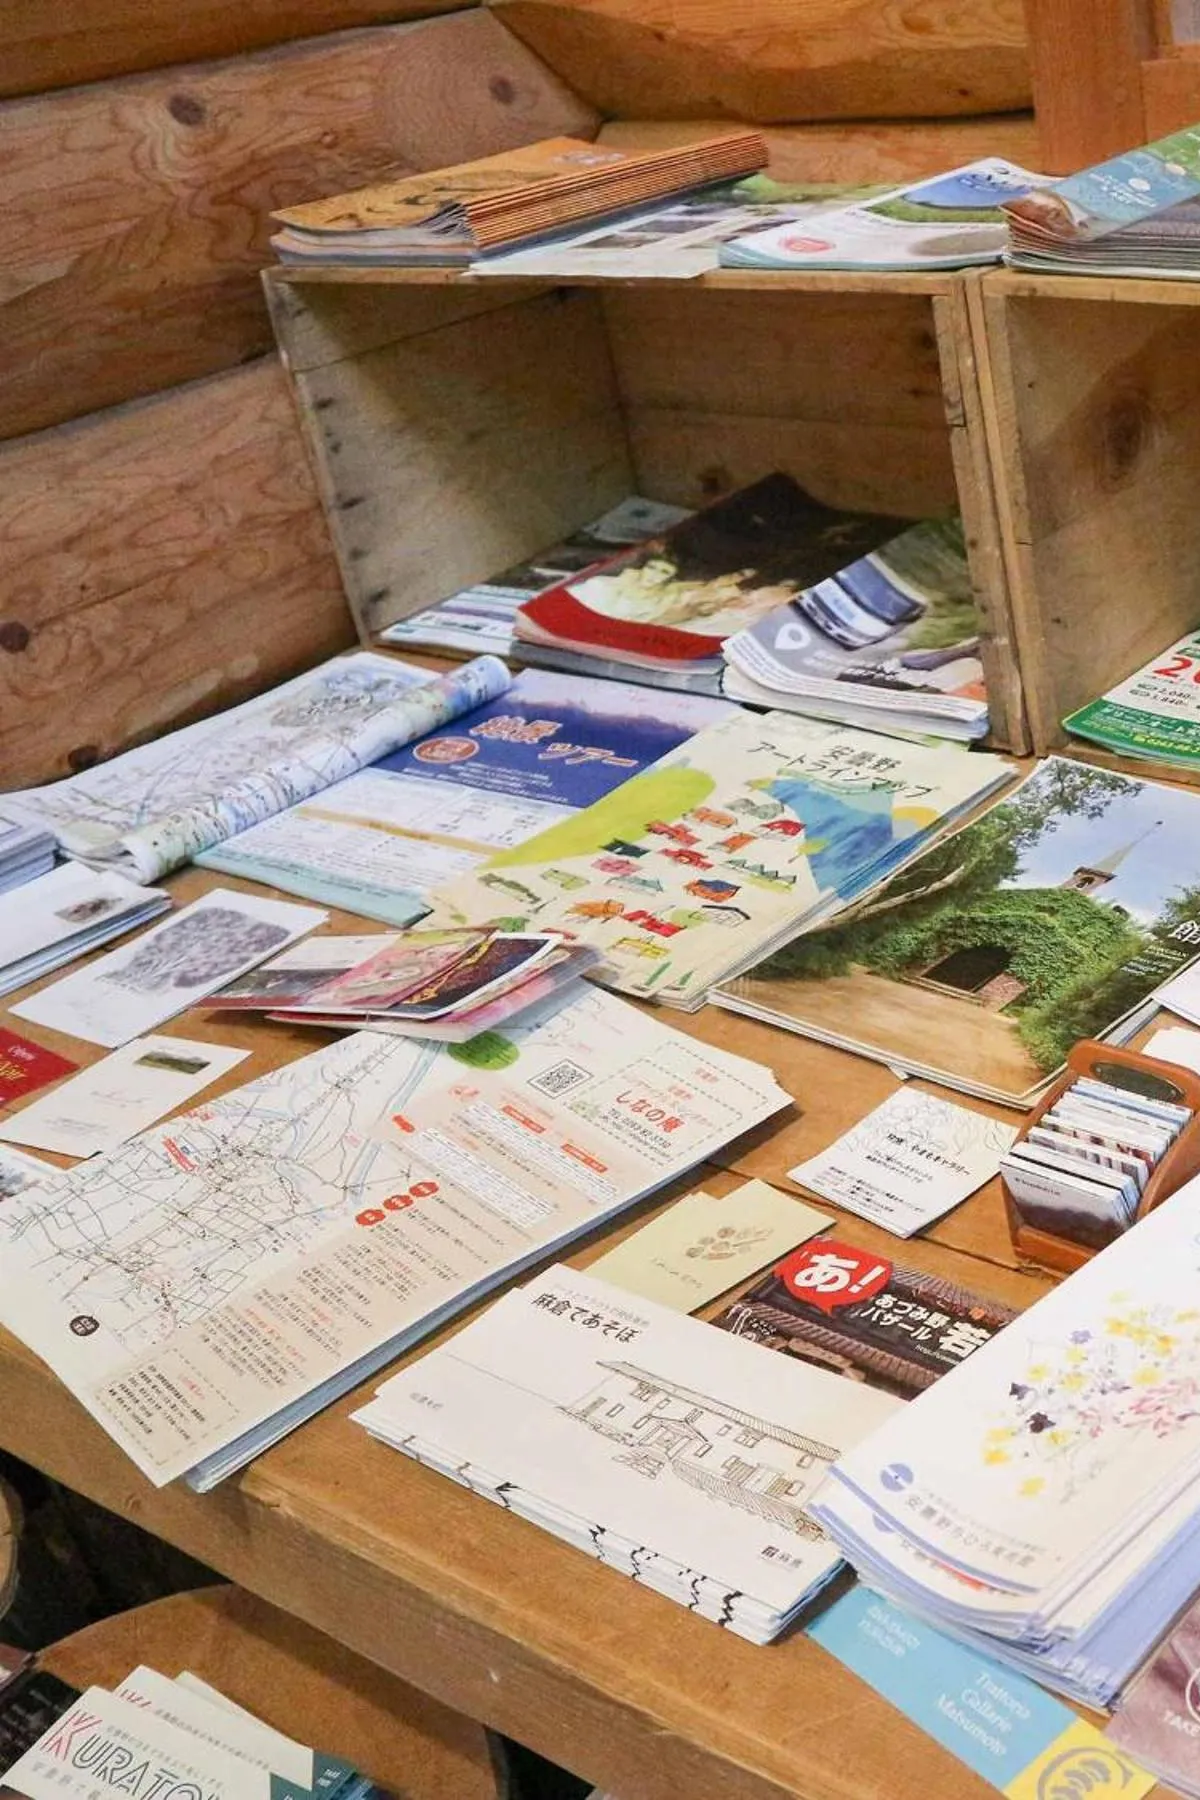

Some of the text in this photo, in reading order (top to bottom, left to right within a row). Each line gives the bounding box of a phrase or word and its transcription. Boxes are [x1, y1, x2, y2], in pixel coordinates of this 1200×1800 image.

[859, 1306, 933, 1341] バザール
[875, 1293, 952, 1329] あづみ野
